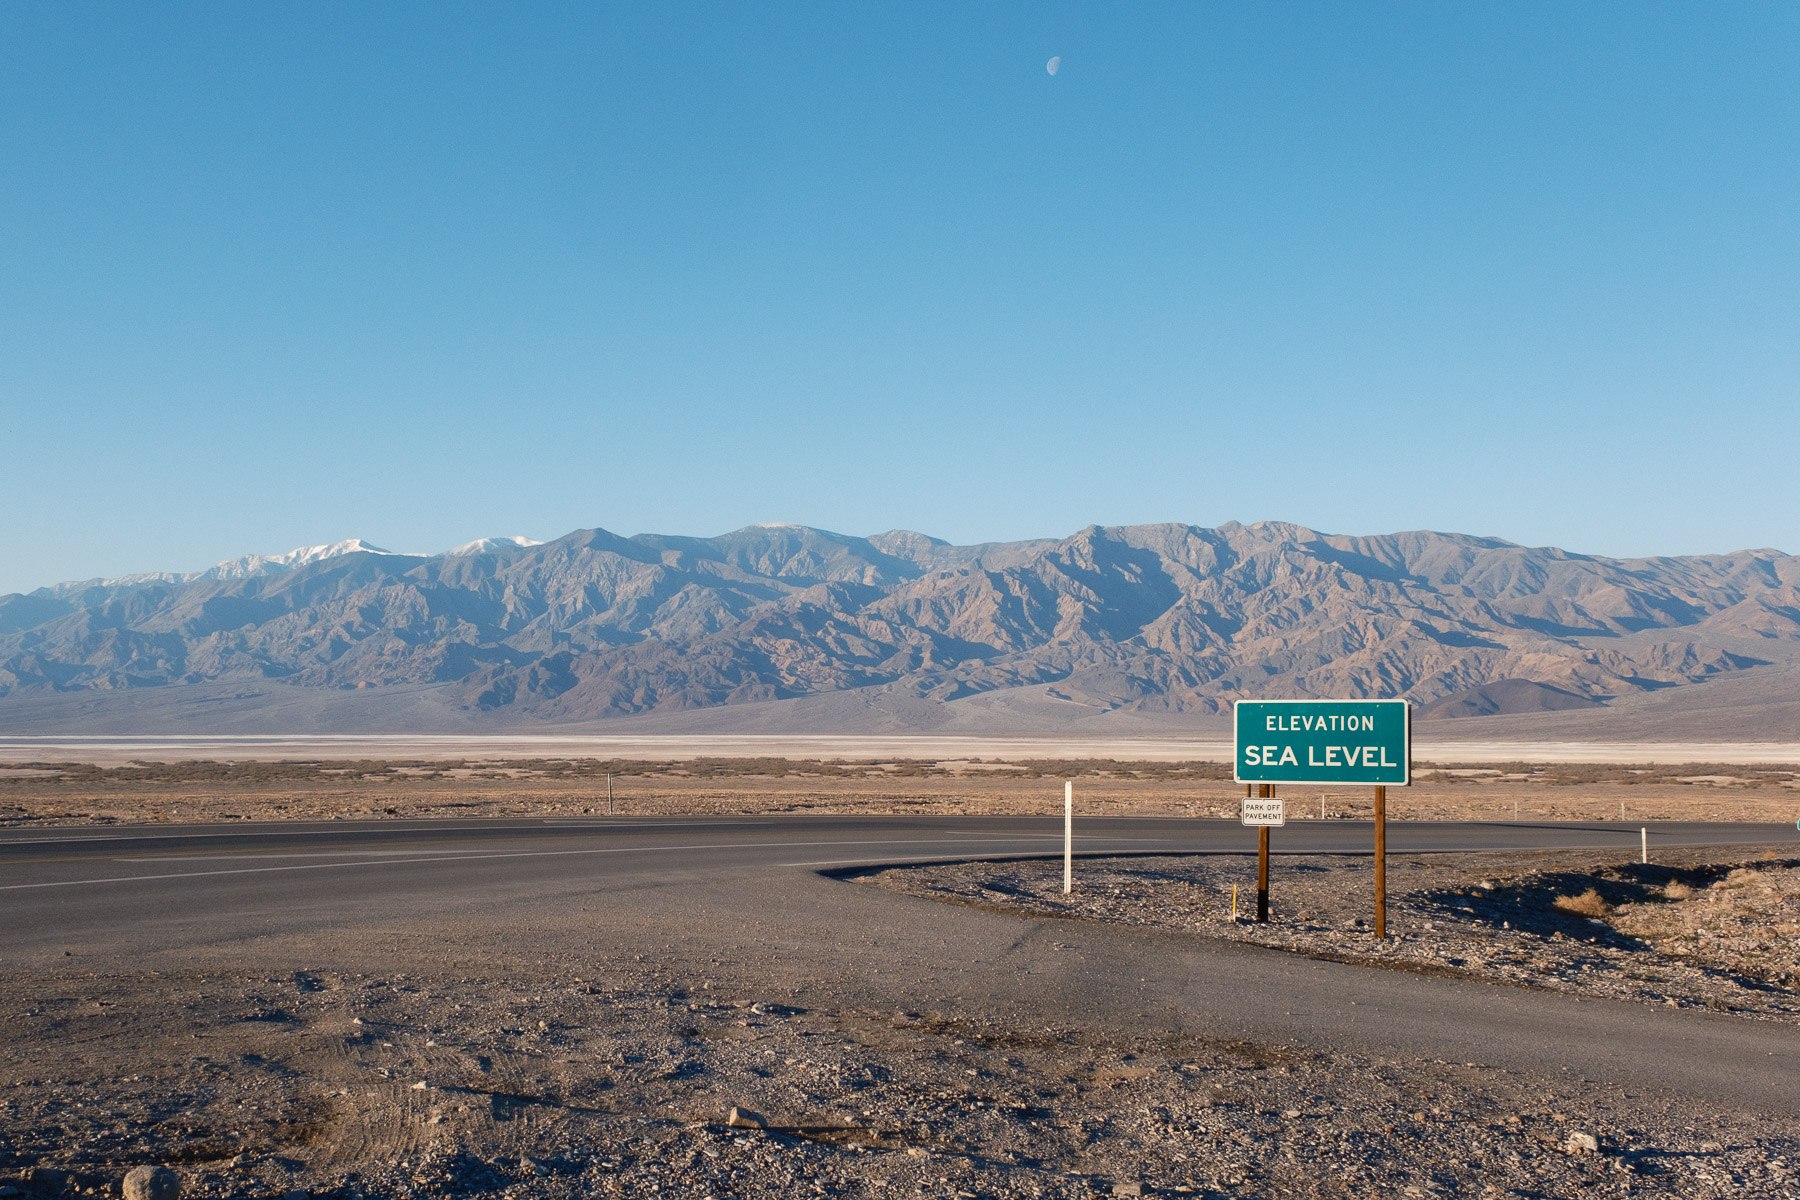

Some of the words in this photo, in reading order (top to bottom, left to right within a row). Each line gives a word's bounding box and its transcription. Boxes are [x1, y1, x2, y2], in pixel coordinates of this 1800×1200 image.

[1266, 715, 1374, 732] ELEVATION
[1244, 745, 1299, 766] SEA
[1308, 746, 1397, 767] LEVEL
